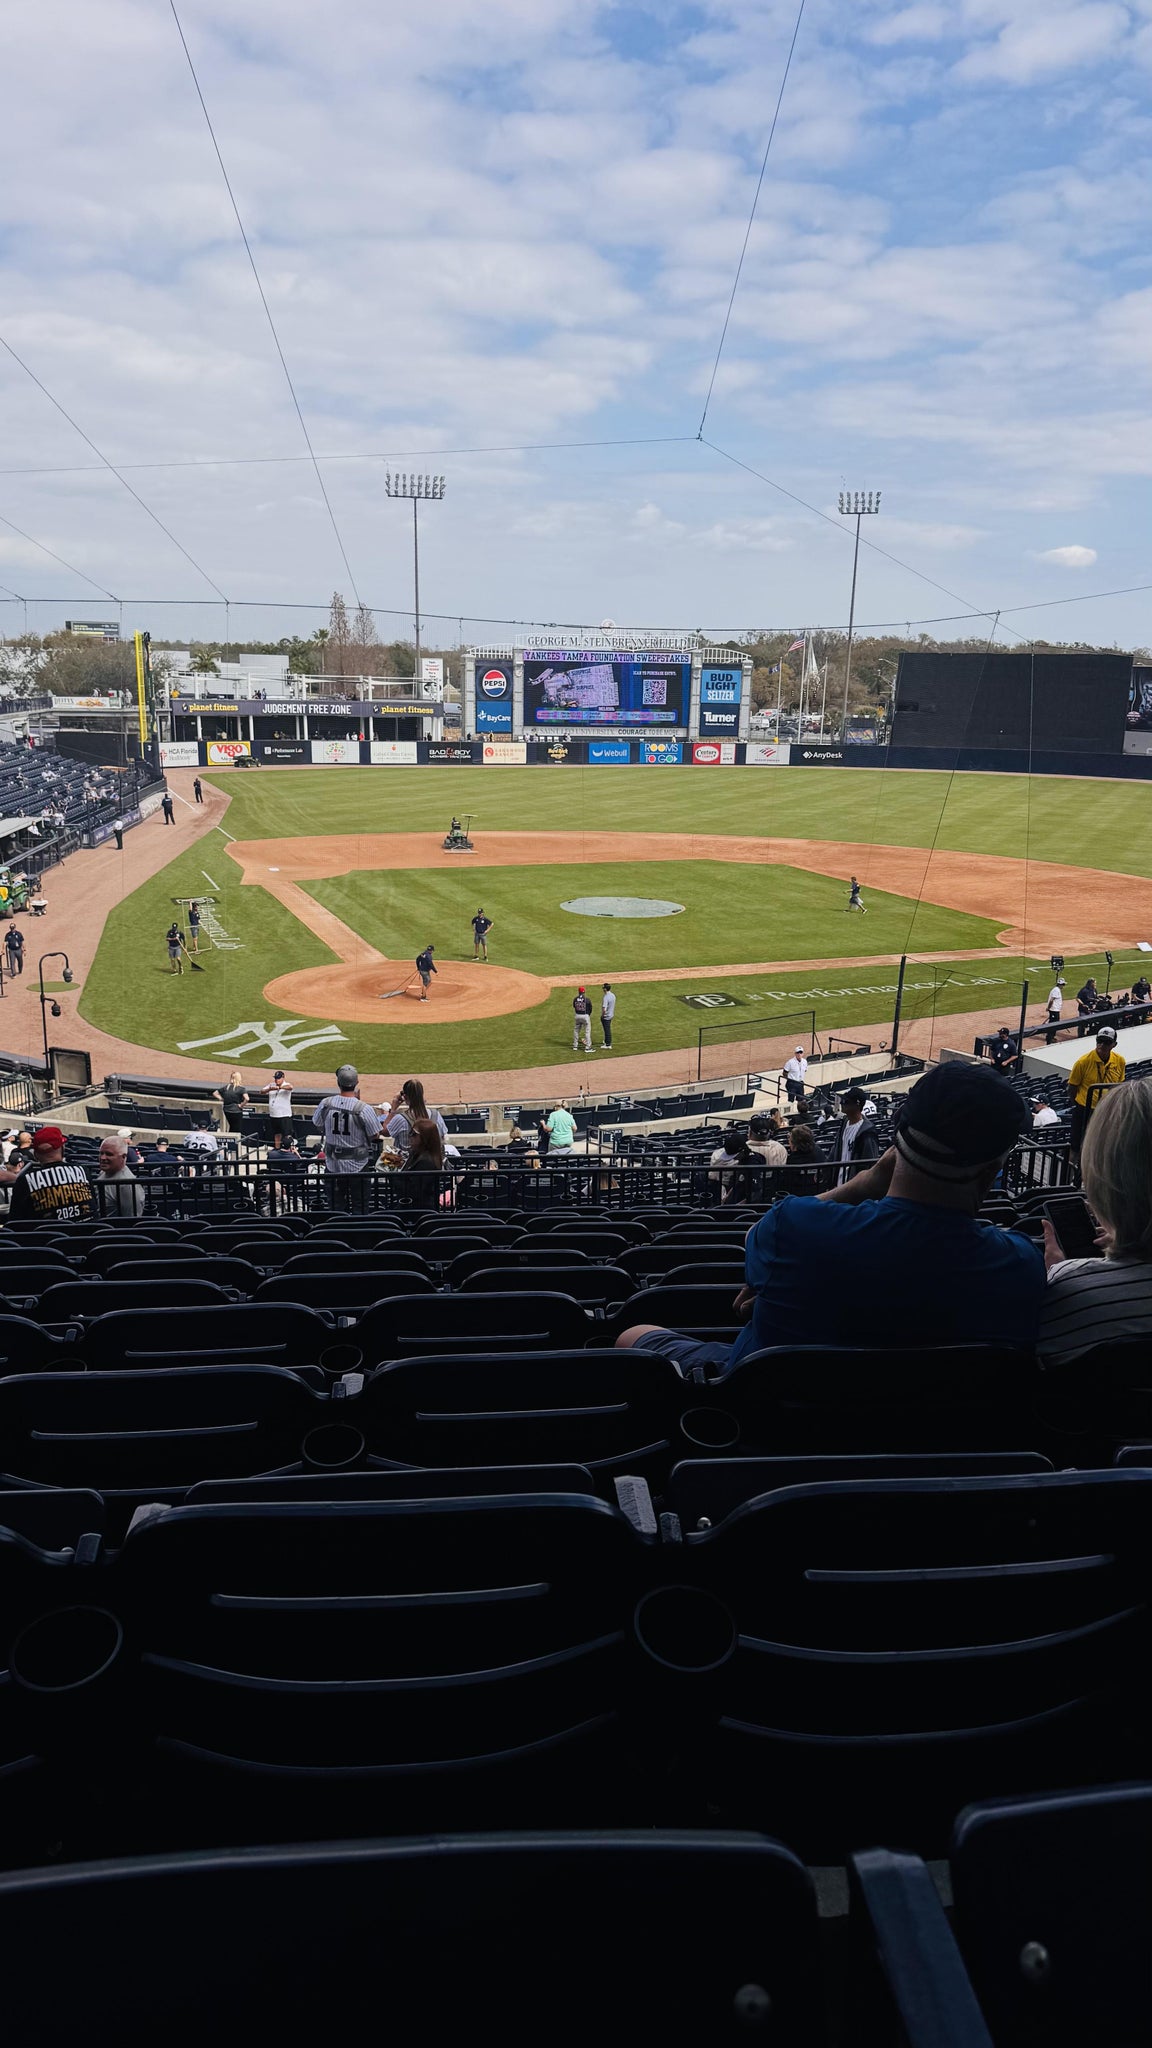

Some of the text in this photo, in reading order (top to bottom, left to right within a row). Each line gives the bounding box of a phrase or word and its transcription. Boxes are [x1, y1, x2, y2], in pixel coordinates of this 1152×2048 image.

[528, 636, 567, 647] GEORGE
[583, 637, 657, 649] STEINBRENNER
[658, 638, 687, 649] FIELD
[525, 651, 690, 663] YANKEES TAMPA FOUNDATION SWEEPSTAKES
[710, 673, 733, 682] BUD
[705, 682, 737, 690] LIGHT
[707, 690, 734, 701] SELTZER
[189, 703, 239, 713] planet fitness
[262, 703, 352, 715] JUDGEMENT FREE ZONE
[381, 706, 434, 714] planet fitness
[487, 714, 511, 723] BayCare
[703, 712, 737, 722] Turner
[644, 743, 678, 752] ROOMS
[604, 749, 627, 757] Webull
[813, 752, 843, 760] AnyDesk
[645, 754, 673, 763] TO GO
[764, 982, 947, 1001] Performance
[946, 977, 1006, 987] Lab
[176, 1020, 349, 1063] NY
[332, 1112, 350, 1136] 11
[25, 1166, 90, 1193] NATIONAL
[56, 1205, 80, 1220] 2025
